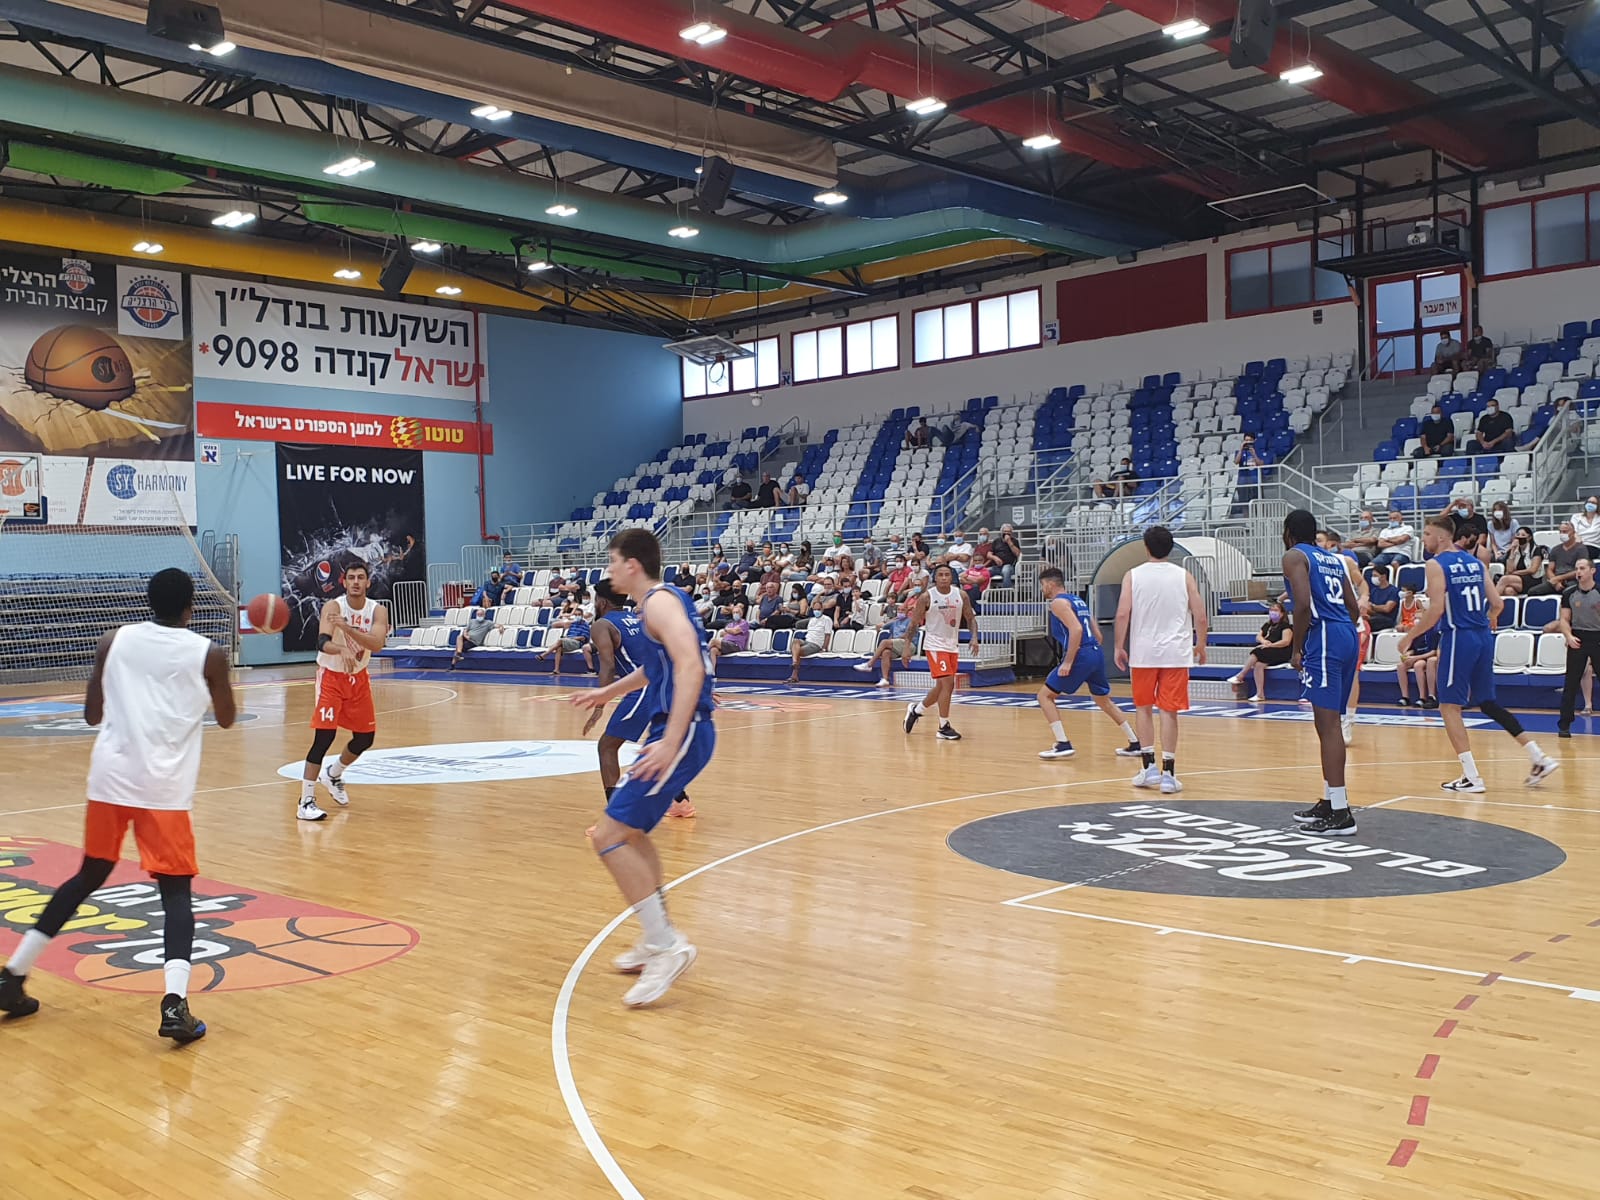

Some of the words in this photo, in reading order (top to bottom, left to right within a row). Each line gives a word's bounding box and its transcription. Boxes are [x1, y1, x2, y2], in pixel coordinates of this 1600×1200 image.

[0, 266, 57, 288] הרצלי
[5, 287, 49, 306] הבית
[55, 293, 108, 315] קבוצת
[1424, 303, 1445, 314] מעבר
[1446, 301, 1458, 313] אין
[340, 306, 469, 347] השקעות
[314, 345, 392, 386] קנדה
[394, 348, 484, 387] ישראל
[234, 410, 291, 431] בישראל
[294, 417, 347, 435] הספורט
[350, 420, 382, 438] למען
[425, 425, 464, 443] טוטו
[204, 450, 217, 463] א
[114, 474, 130, 491] SY
[137, 474, 188, 492] HARMONY
[286, 463, 325, 481] LIVE
[330, 465, 366, 483] FOR
[372, 468, 413, 485] NOW
[1324, 575, 1345, 605] 32
[1461, 586, 1481, 611] 11
[351, 614, 362, 626] 14
[940, 660, 947, 671] 3
[319, 706, 335, 722] 14
[1108, 804, 1488, 878] פרשקובסקי
